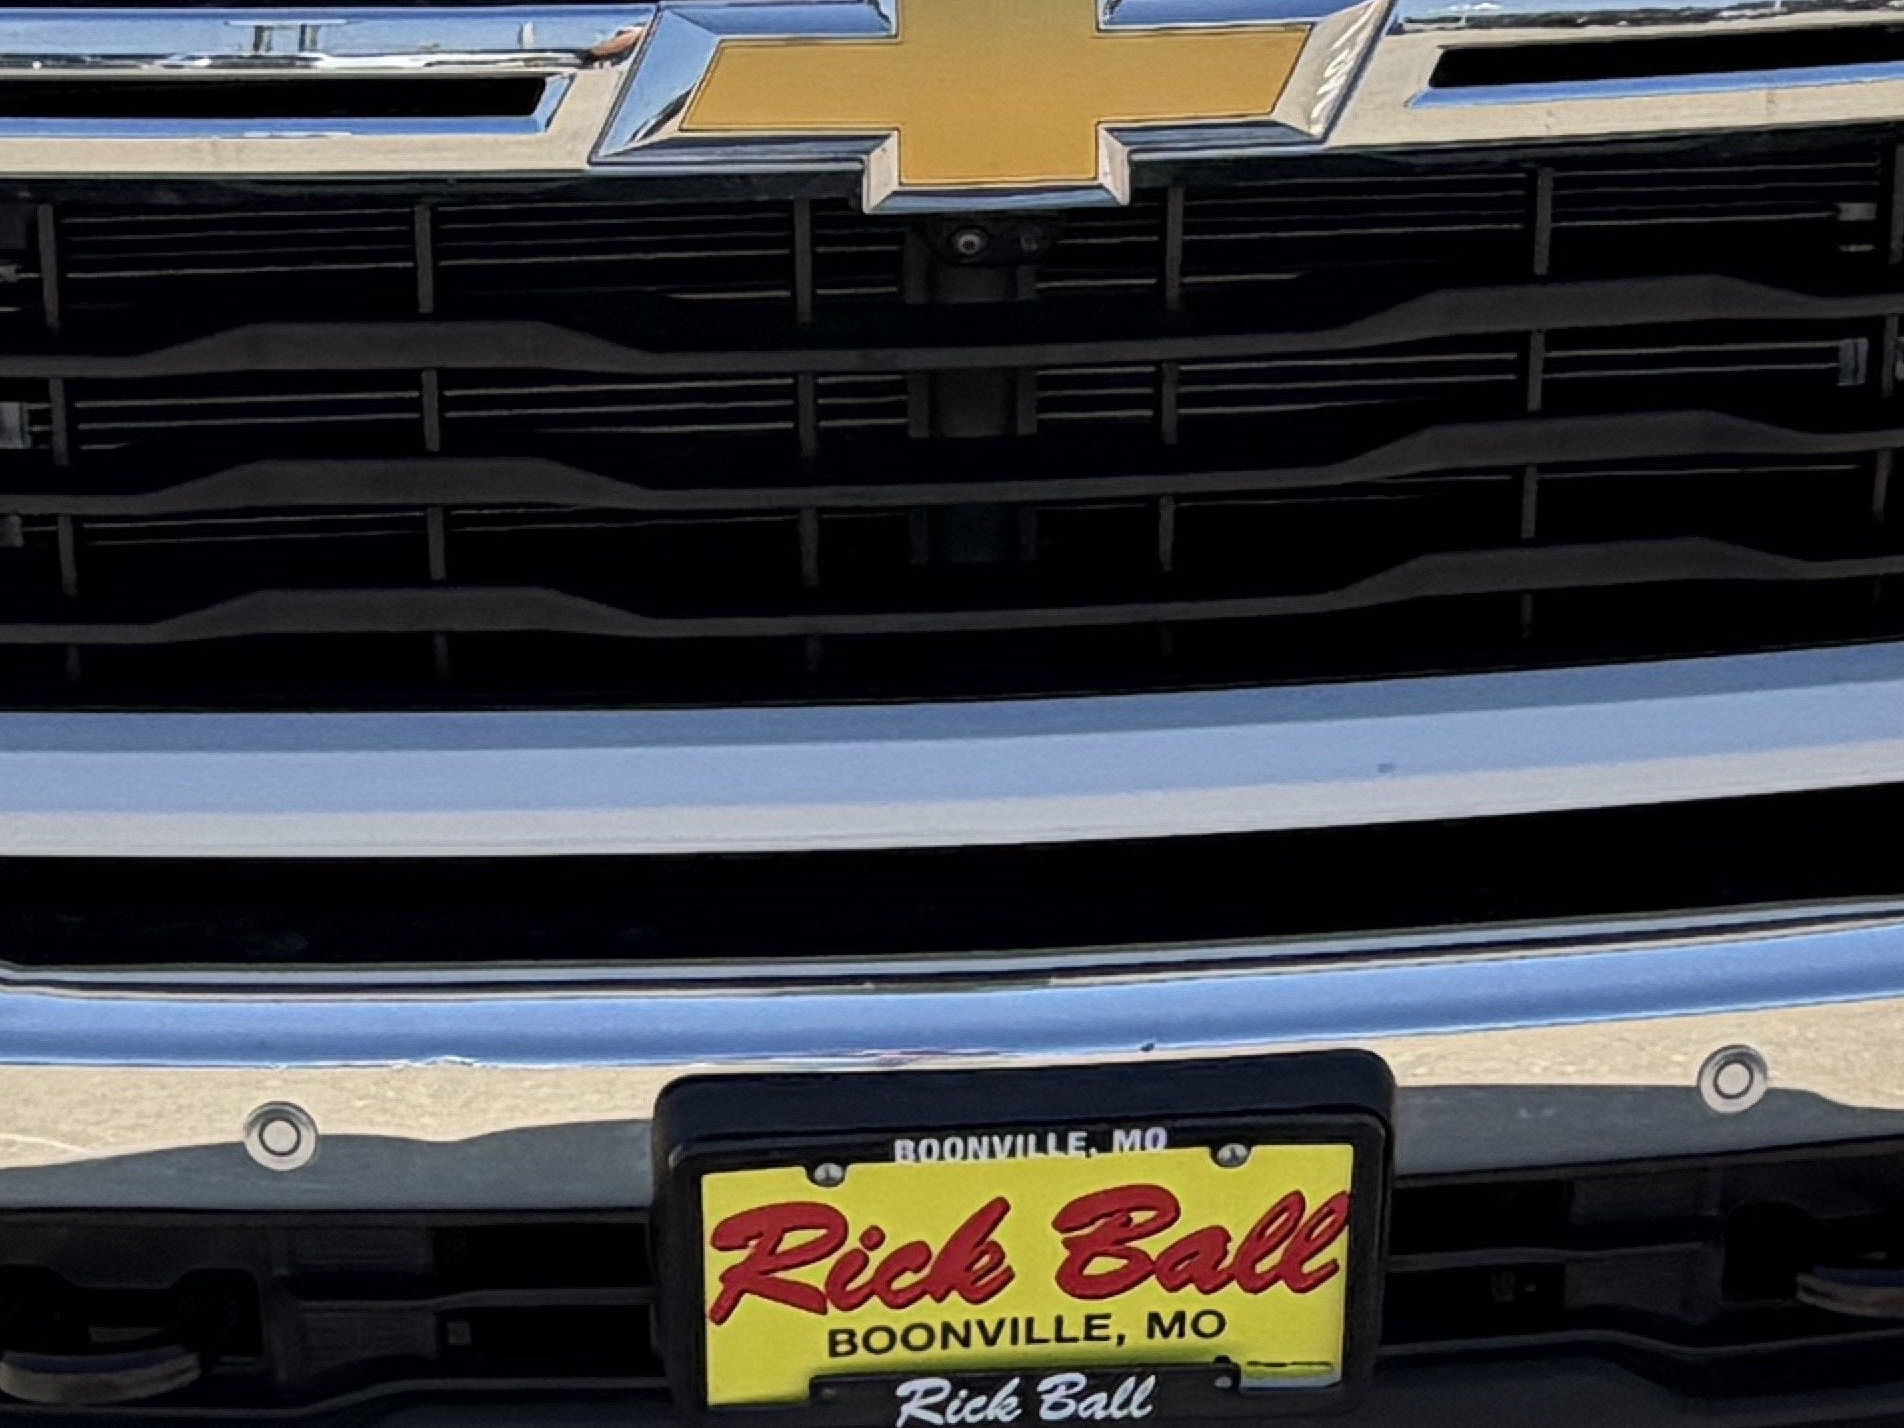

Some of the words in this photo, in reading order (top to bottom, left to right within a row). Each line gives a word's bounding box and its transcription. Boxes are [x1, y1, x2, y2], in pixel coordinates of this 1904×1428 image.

[893, 1129, 1096, 1163] BOONVILLE,
[1112, 1126, 1168, 1155] MO
[708, 1196, 1017, 1326] Rick
[1051, 1184, 1351, 1302] Ball
[826, 1313, 1127, 1359] BOONVILLE,
[1146, 1309, 1227, 1341] MO
[1037, 1374, 1153, 1425] Ball
